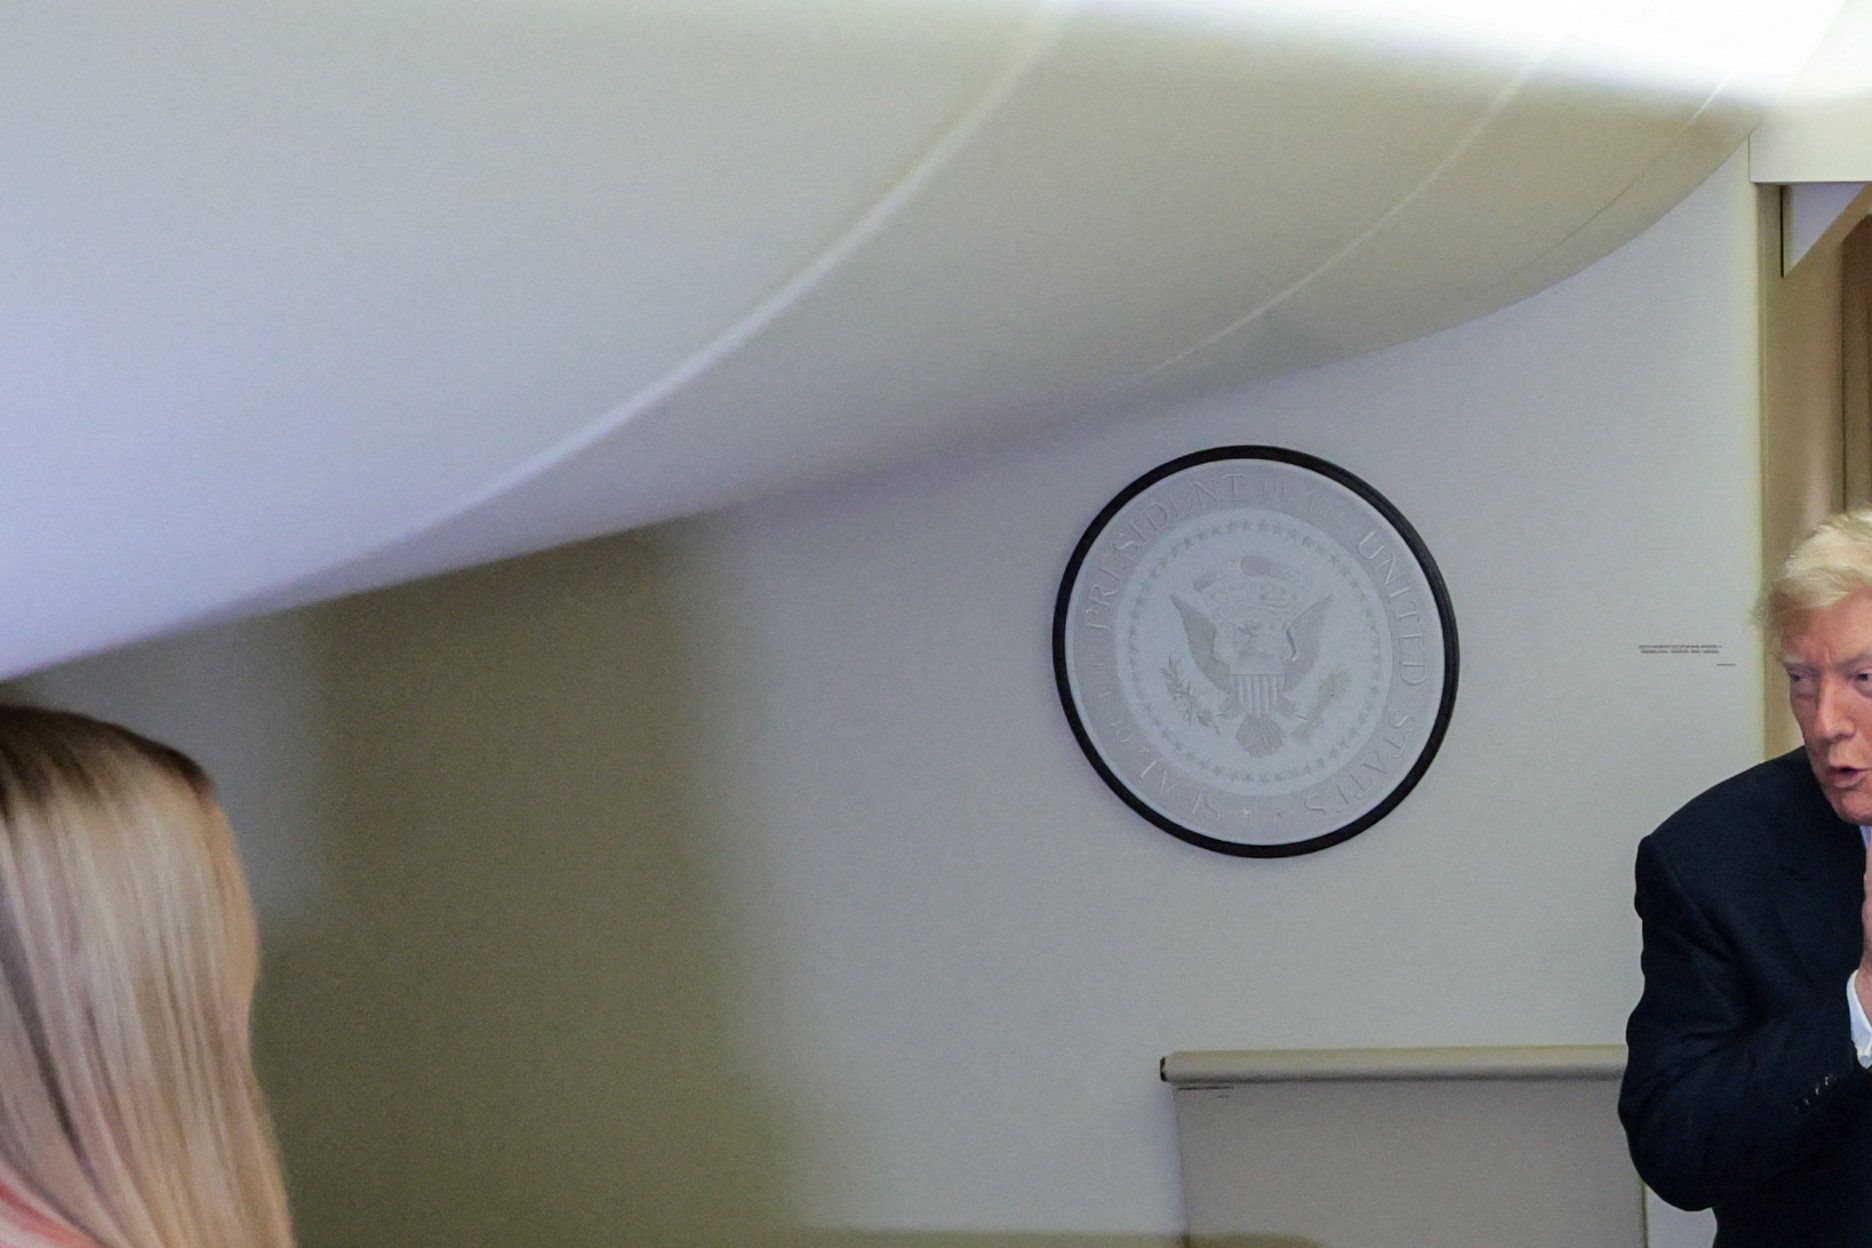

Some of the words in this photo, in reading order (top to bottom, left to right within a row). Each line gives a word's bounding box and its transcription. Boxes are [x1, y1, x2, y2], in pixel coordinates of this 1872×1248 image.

[1083, 473, 1246, 630] PRESIDENT
[1357, 530, 1428, 687] UNITED
[1303, 708, 1416, 823] STATES
